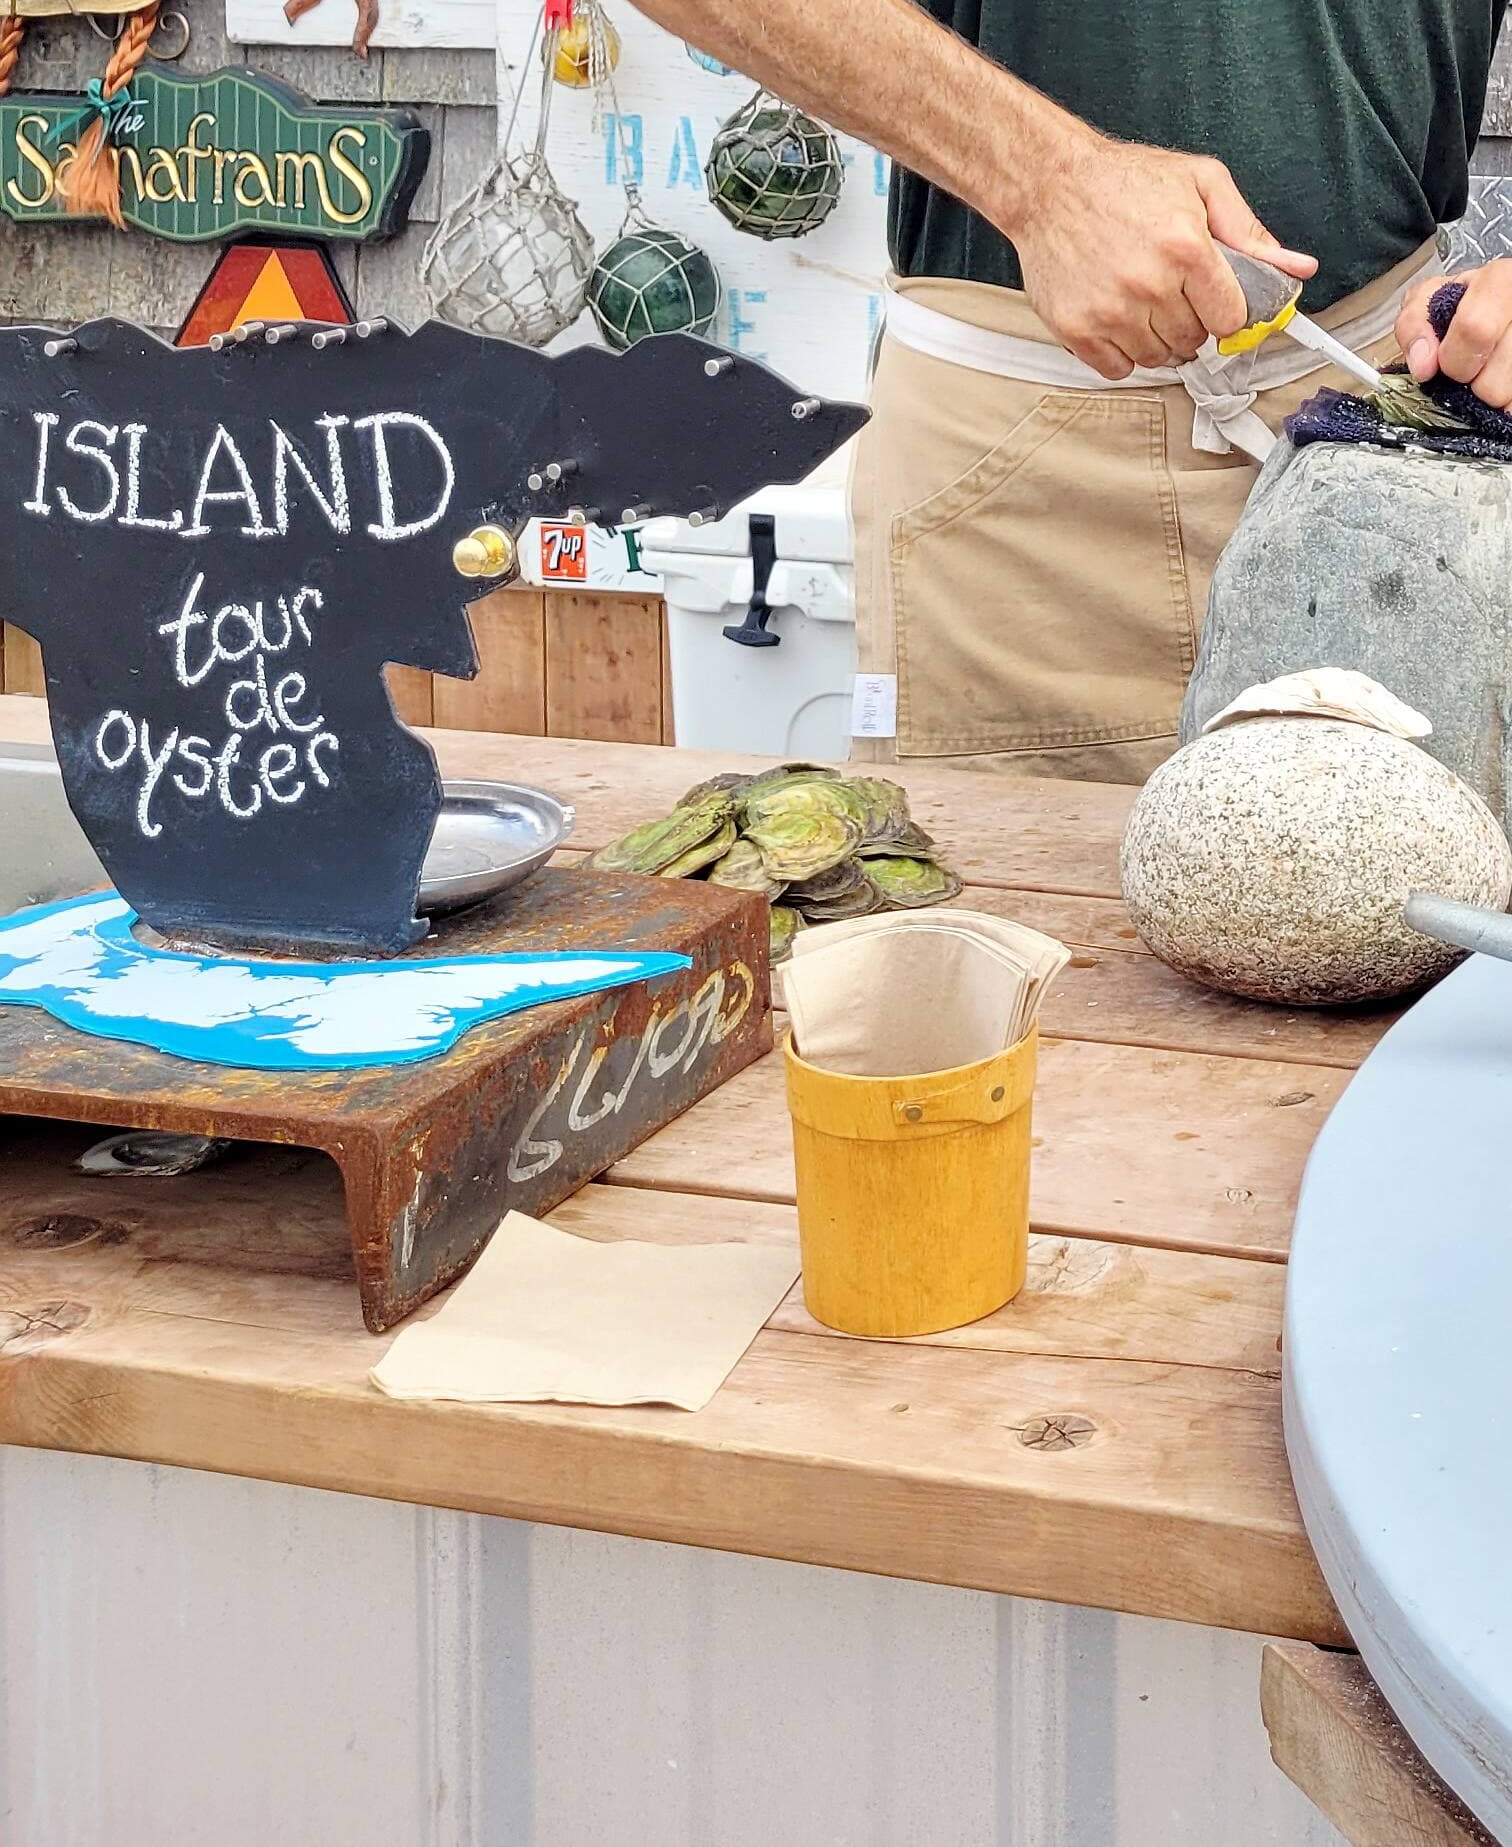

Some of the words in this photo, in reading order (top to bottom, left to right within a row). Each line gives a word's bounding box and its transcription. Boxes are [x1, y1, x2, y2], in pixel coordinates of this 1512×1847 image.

[109, 99, 149, 135] The
[24, 411, 457, 543] ISLAND
[158, 570, 326, 689] tour
[225, 654, 326, 738] de
[95, 708, 340, 838] oyster
